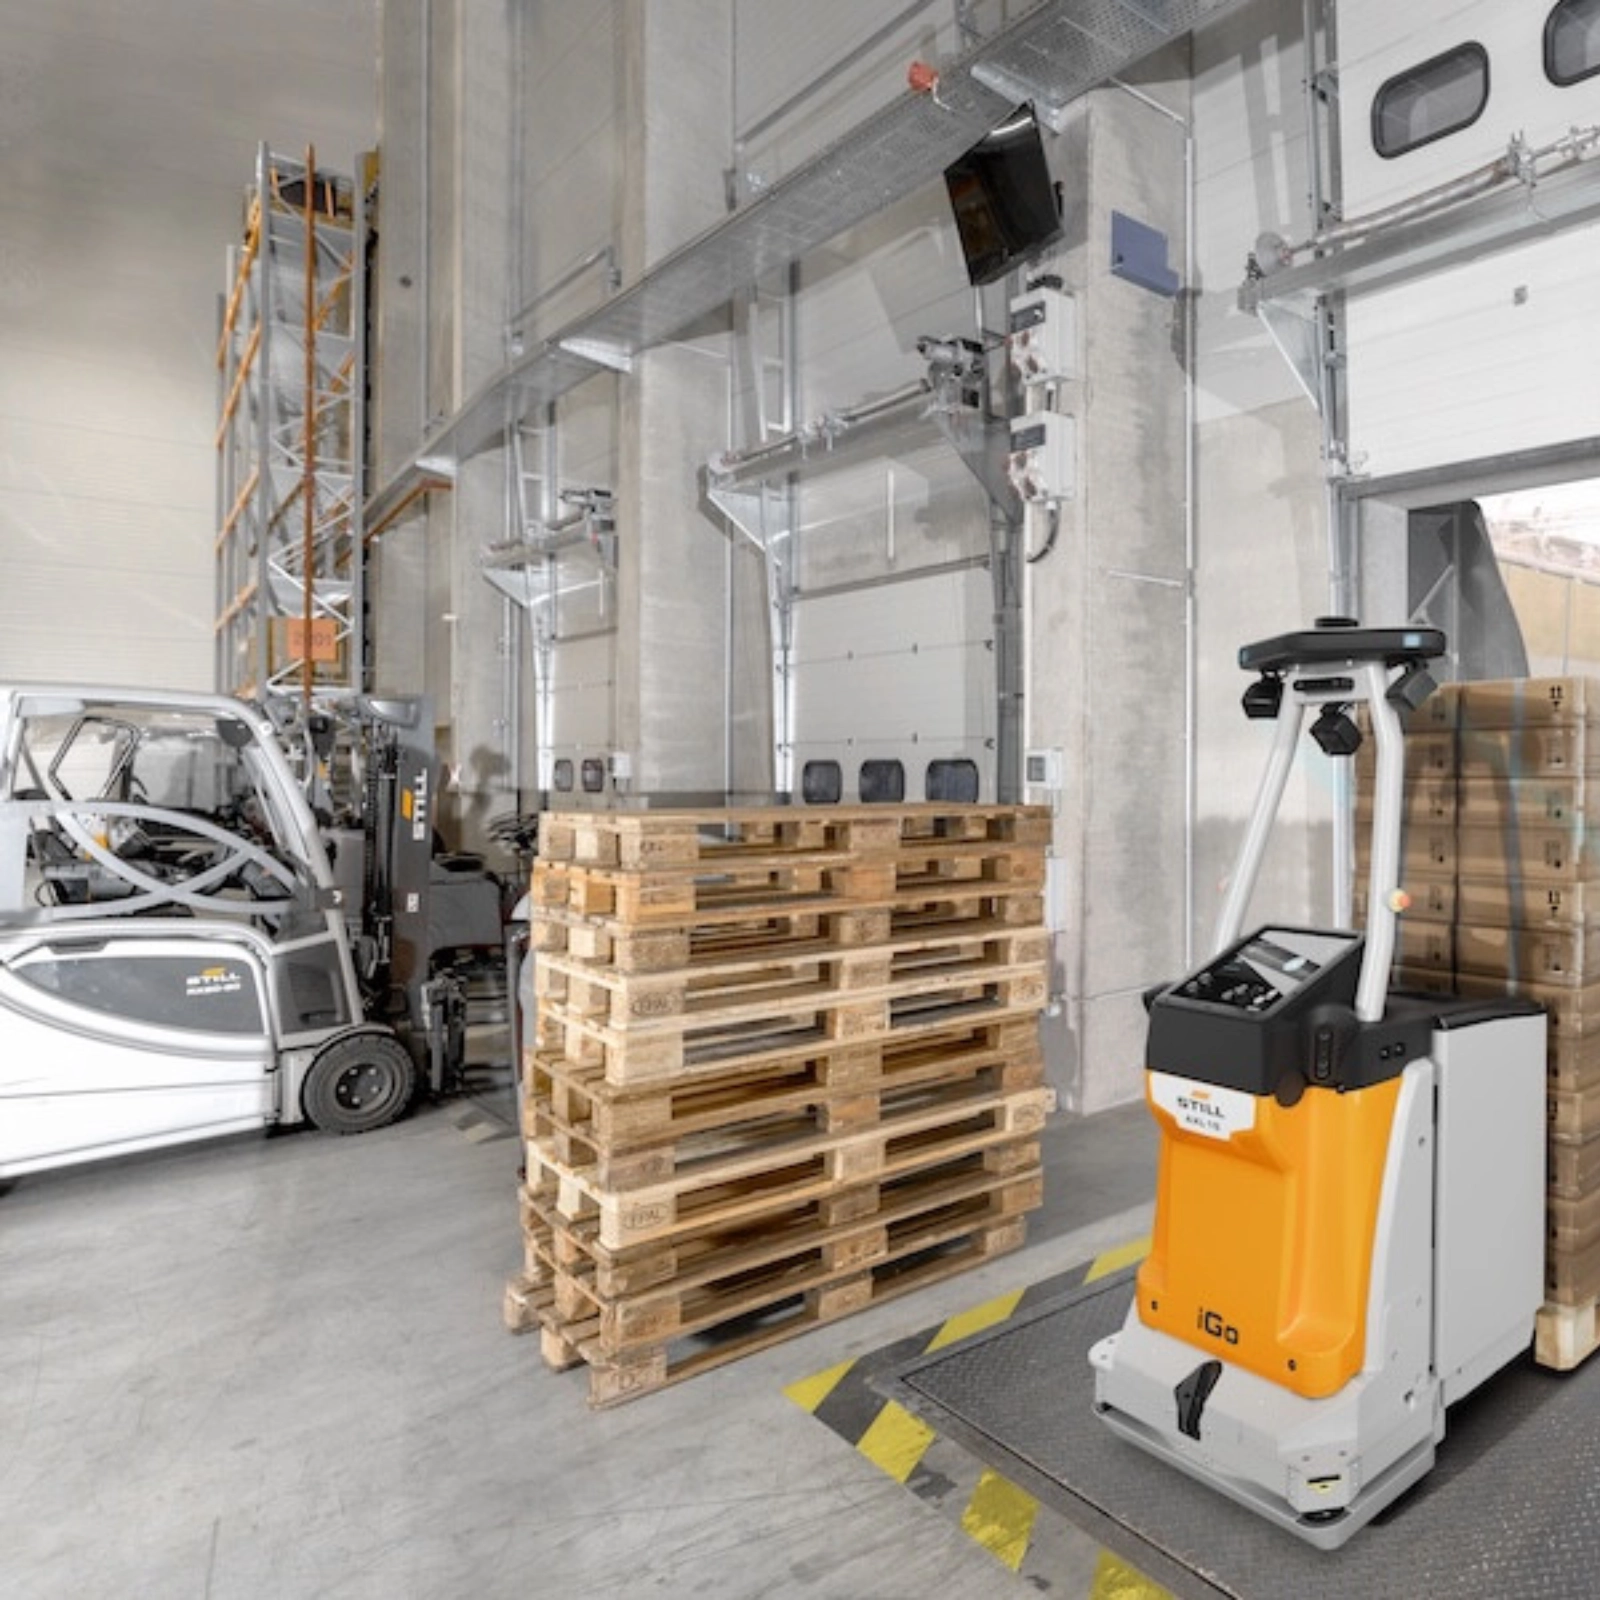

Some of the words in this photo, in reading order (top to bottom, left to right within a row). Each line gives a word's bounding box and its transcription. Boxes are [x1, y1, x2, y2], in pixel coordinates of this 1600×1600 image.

[412, 767, 428, 841] STILL
[186, 972, 241, 986] STILL
[1177, 1097, 1225, 1119] STILL
[1196, 1306, 1239, 1345] iGo
